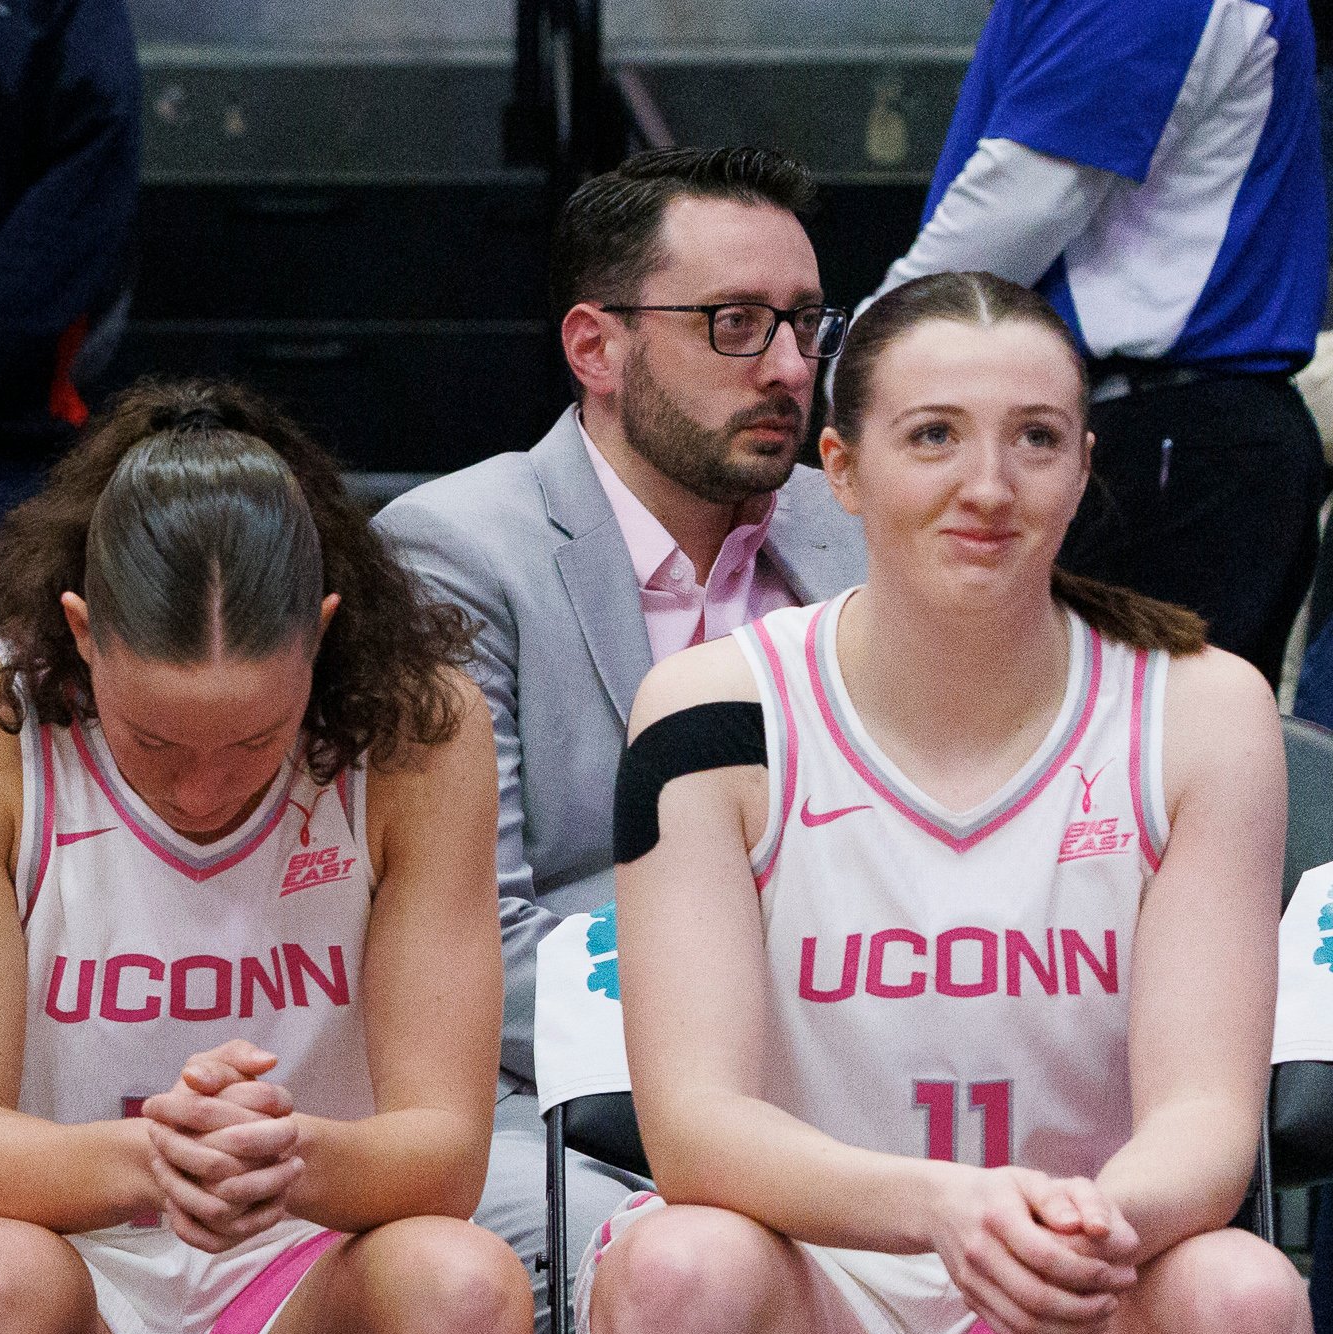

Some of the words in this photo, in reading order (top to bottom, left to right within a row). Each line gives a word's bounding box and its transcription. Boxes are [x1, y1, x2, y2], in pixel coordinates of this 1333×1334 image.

[1065, 817, 1119, 838] BIG
[288, 845, 340, 869] BIG
[1059, 832, 1135, 855] EAST
[281, 858, 357, 888] EAST
[798, 926, 1120, 1003] UCONN
[44, 943, 351, 1023] UCONN
[912, 1077, 1014, 1168] 11
